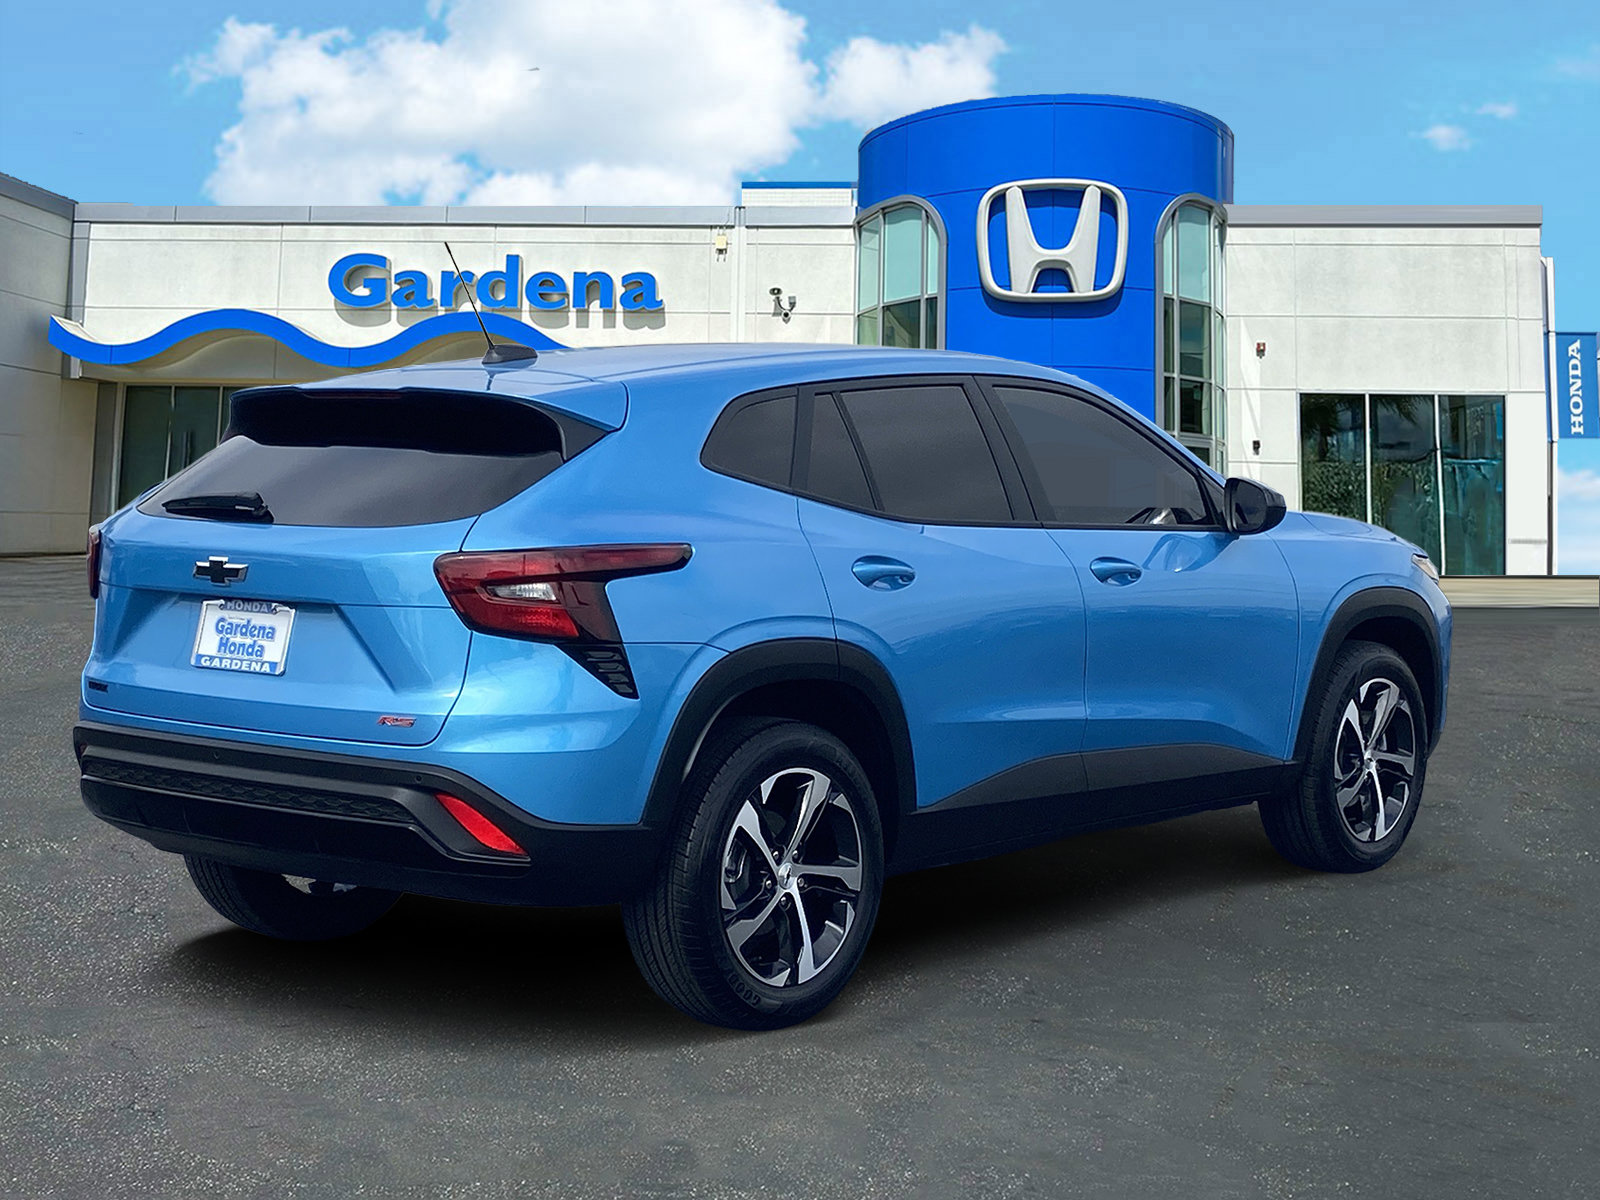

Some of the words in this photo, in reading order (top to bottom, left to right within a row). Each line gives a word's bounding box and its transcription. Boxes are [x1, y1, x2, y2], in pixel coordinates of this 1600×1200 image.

[328, 253, 663, 310] Gardena
[1568, 339, 1584, 435] HONDA
[226, 600, 269, 612] HONDA
[215, 616, 276, 640] Gardena
[217, 636, 265, 658] Honda
[200, 656, 271, 673] GARDENA
